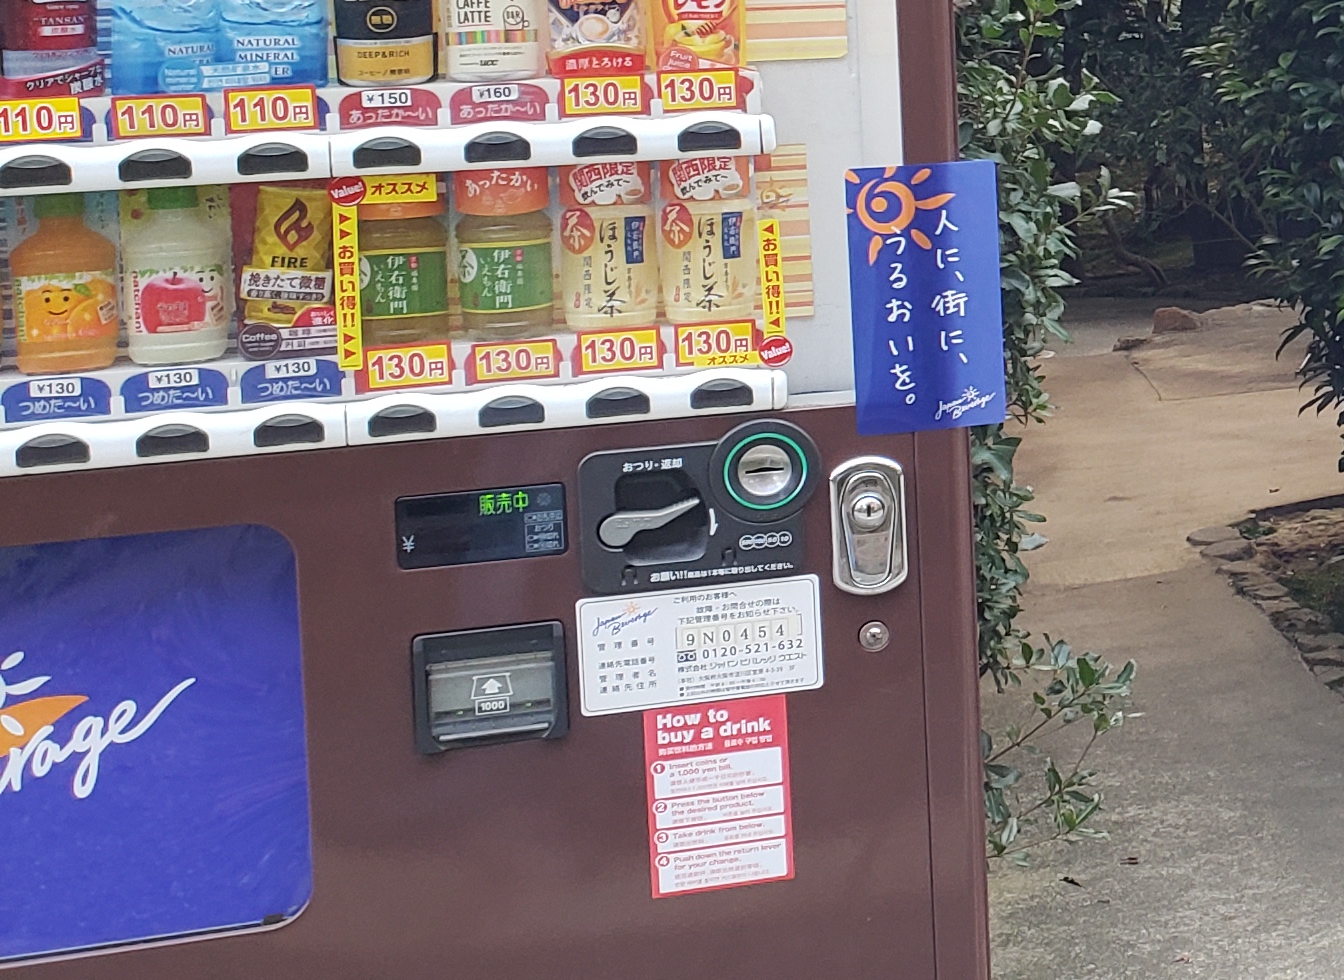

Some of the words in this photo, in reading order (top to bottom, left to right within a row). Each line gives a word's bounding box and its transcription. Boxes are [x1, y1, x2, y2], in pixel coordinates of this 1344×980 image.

[457, 9, 492, 25] LATTE
[236, 38, 299, 48] NATURAL
[357, 48, 410, 58] DEEP&RICH
[238, 51, 297, 61] MINERAL
[565, 56, 631, 71] 濃厚とろける
[670, 49, 692, 61] Fruit
[366, 91, 409, 105] ¥150
[478, 86, 512, 99] ¥160
[567, 81, 639, 109] 130円
[663, 77, 733, 104] 130円
[0, 105, 75, 133] 110円
[121, 103, 200, 129] 110円
[233, 95, 308, 123] 110円
[572, 162, 634, 190] 関西限定
[671, 157, 732, 188] 関西限定
[330, 181, 364, 199] Value!
[371, 181, 429, 195] オススメ
[465, 170, 538, 198] あったかい
[563, 211, 591, 251] 茶
[663, 206, 690, 244] 茶
[270, 255, 309, 268] FIRE
[598, 221, 626, 318] ほうじ茶
[696, 216, 724, 312] ほうじ茶
[247, 271, 327, 291] 挽きたて微糖
[339, 245, 357, 327] お買い得!!
[373, 263, 387, 303] いえもん
[386, 256, 407, 314] 伊右衛門
[480, 257, 493, 297] いえもん
[493, 249, 513, 308] 伊右衛門
[584, 255, 593, 309] 関西限定
[682, 251, 692, 303] 関西限定
[763, 238, 780, 314] お買い得!!
[931, 209, 969, 364] 人に、街に、
[885, 225, 916, 405] うるおいを。
[242, 333, 278, 344] Coffee
[681, 329, 749, 356] 130円
[584, 336, 653, 364] 130円
[707, 353, 749, 366] オススメ
[761, 342, 792, 362] Value!
[274, 361, 311, 375] ¥130
[371, 352, 445, 381] 130円
[479, 348, 551, 375] 130円
[36, 382, 76, 395] ¥130
[155, 371, 193, 384] ¥130
[935, 397, 964, 420] Japan
[948, 392, 996, 420] Beverage
[622, 458, 683, 472] おつり・返却
[479, 490, 529, 516] 販売中
[402, 535, 415, 553] ¥
[673, 591, 737, 604] ご利用のお客様へ
[592, 612, 627, 636] Japan
[606, 607, 659, 636] Beverage
[702, 638, 803, 659] 0120-521-632
[598, 656, 655, 670] 連絡先電話番号
[677, 663, 707, 673] 株式会社
[600, 680, 657, 694] 連絡先住所
[480, 699, 505, 712] 1000
[656, 713, 702, 729] How
[707, 708, 728, 723] to
[657, 728, 695, 745] buy
[700, 726, 714, 739] a
[719, 717, 772, 737] drink
[671, 801, 695, 810] Press
[712, 794, 738, 803] button
[740, 790, 765, 799] below
[671, 809, 685, 817] the
[687, 804, 718, 815] desired
[673, 831, 693, 840] Take
[695, 827, 716, 837] drink
[718, 824, 737, 833] from
[673, 854, 695, 864] Push
[695, 850, 717, 860] down
[719, 848, 732, 857] the
[733, 845, 759, 855] return
[688, 860, 707, 870] your
